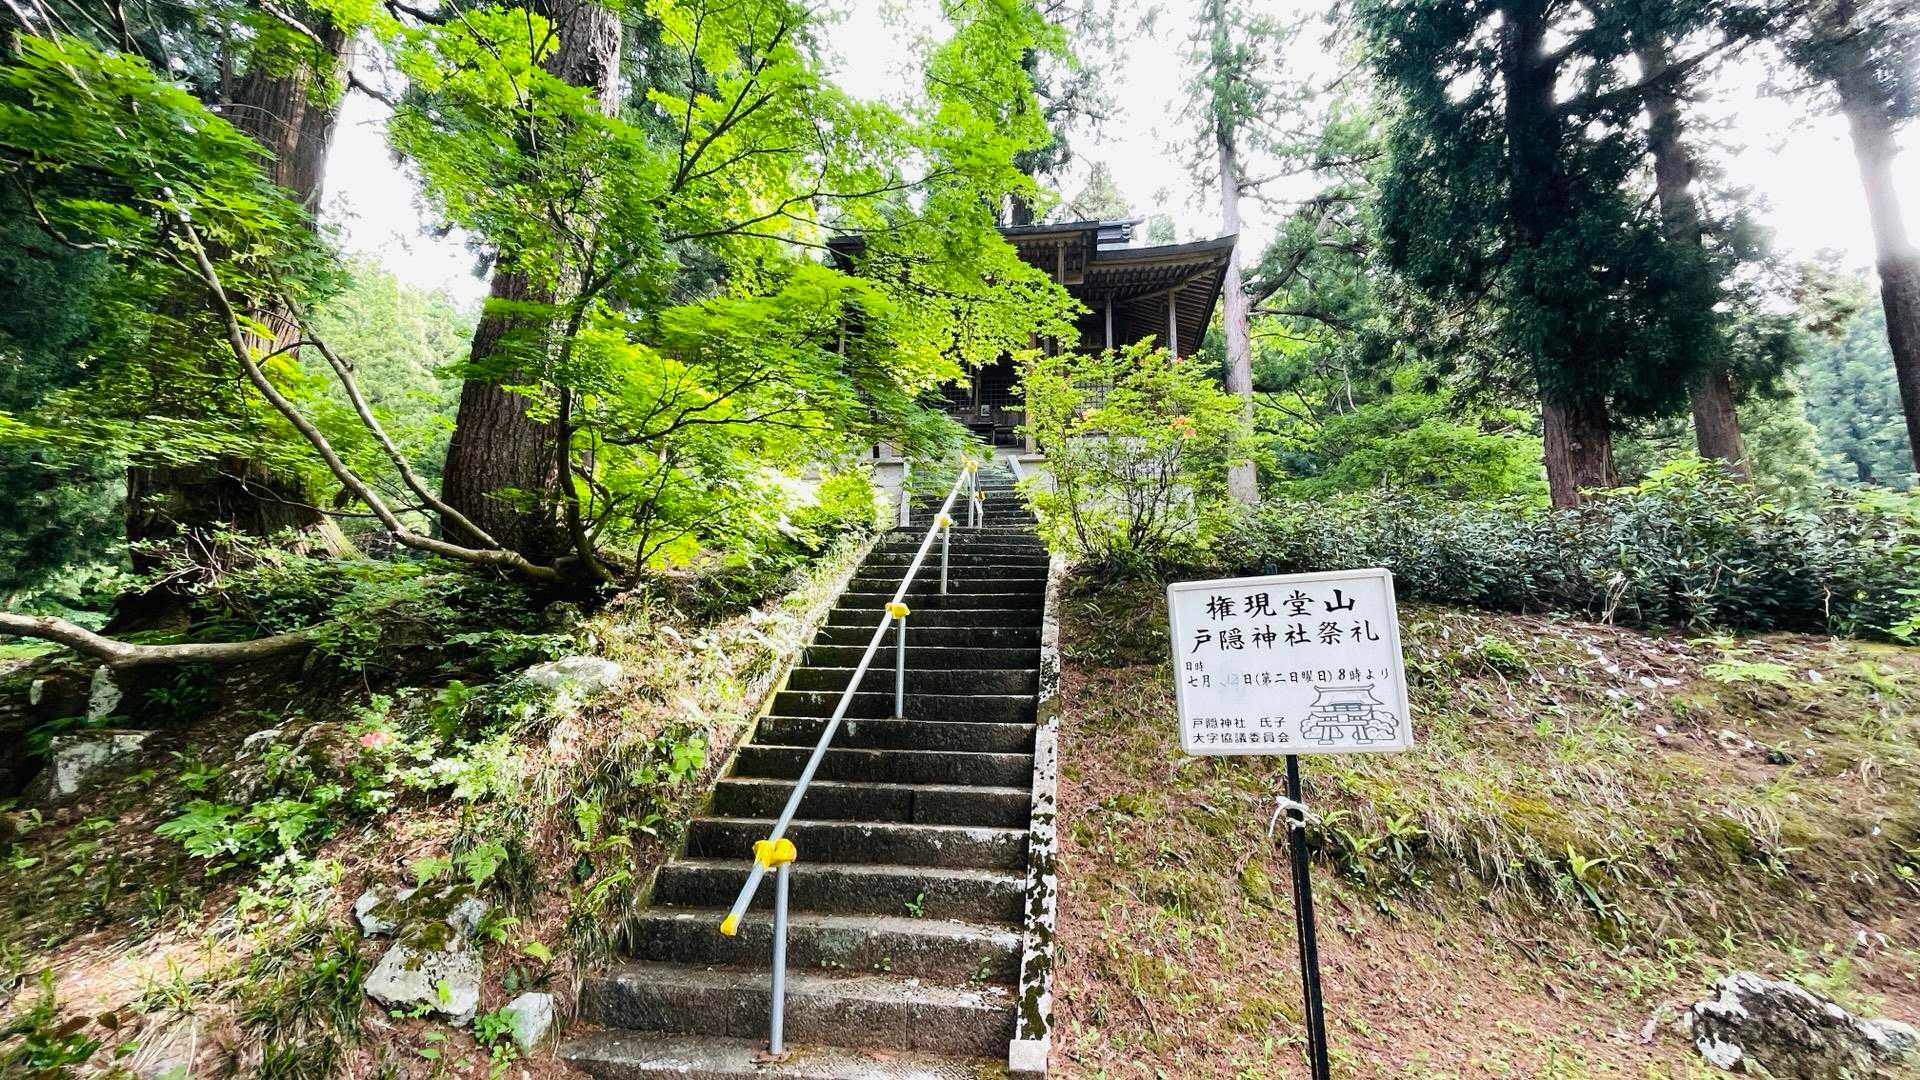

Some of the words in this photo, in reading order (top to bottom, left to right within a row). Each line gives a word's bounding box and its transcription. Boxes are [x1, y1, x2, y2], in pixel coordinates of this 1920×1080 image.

[1206, 589, 1355, 621] 権現堂山
[1192, 620, 1380, 654] 戸隠神社祭礼
[1185, 660, 1204, 671] 日時
[1193, 717, 1246, 729] 戸隠神社
[1259, 716, 1286, 728] 氏子
[1193, 731, 1290, 744] 大字協議委員会
